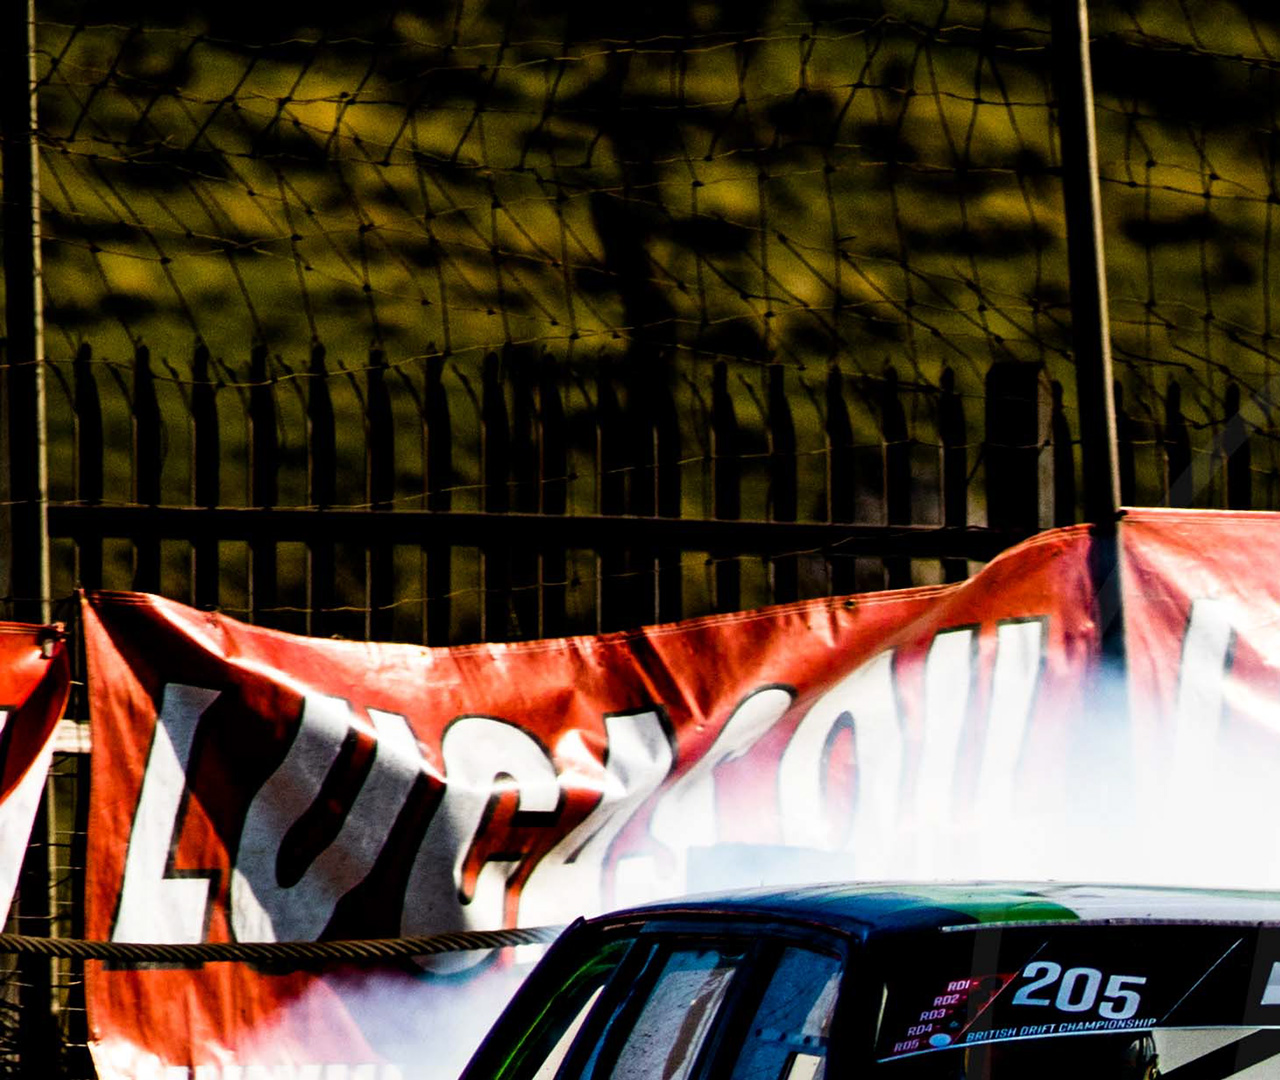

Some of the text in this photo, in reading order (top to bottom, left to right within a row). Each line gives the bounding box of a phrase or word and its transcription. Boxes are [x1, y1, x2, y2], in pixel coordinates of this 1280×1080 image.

[1012, 961, 1147, 1019] 205
[966, 1018, 1157, 1042] BRITISH DRIFT CHAMPIONSHIP
